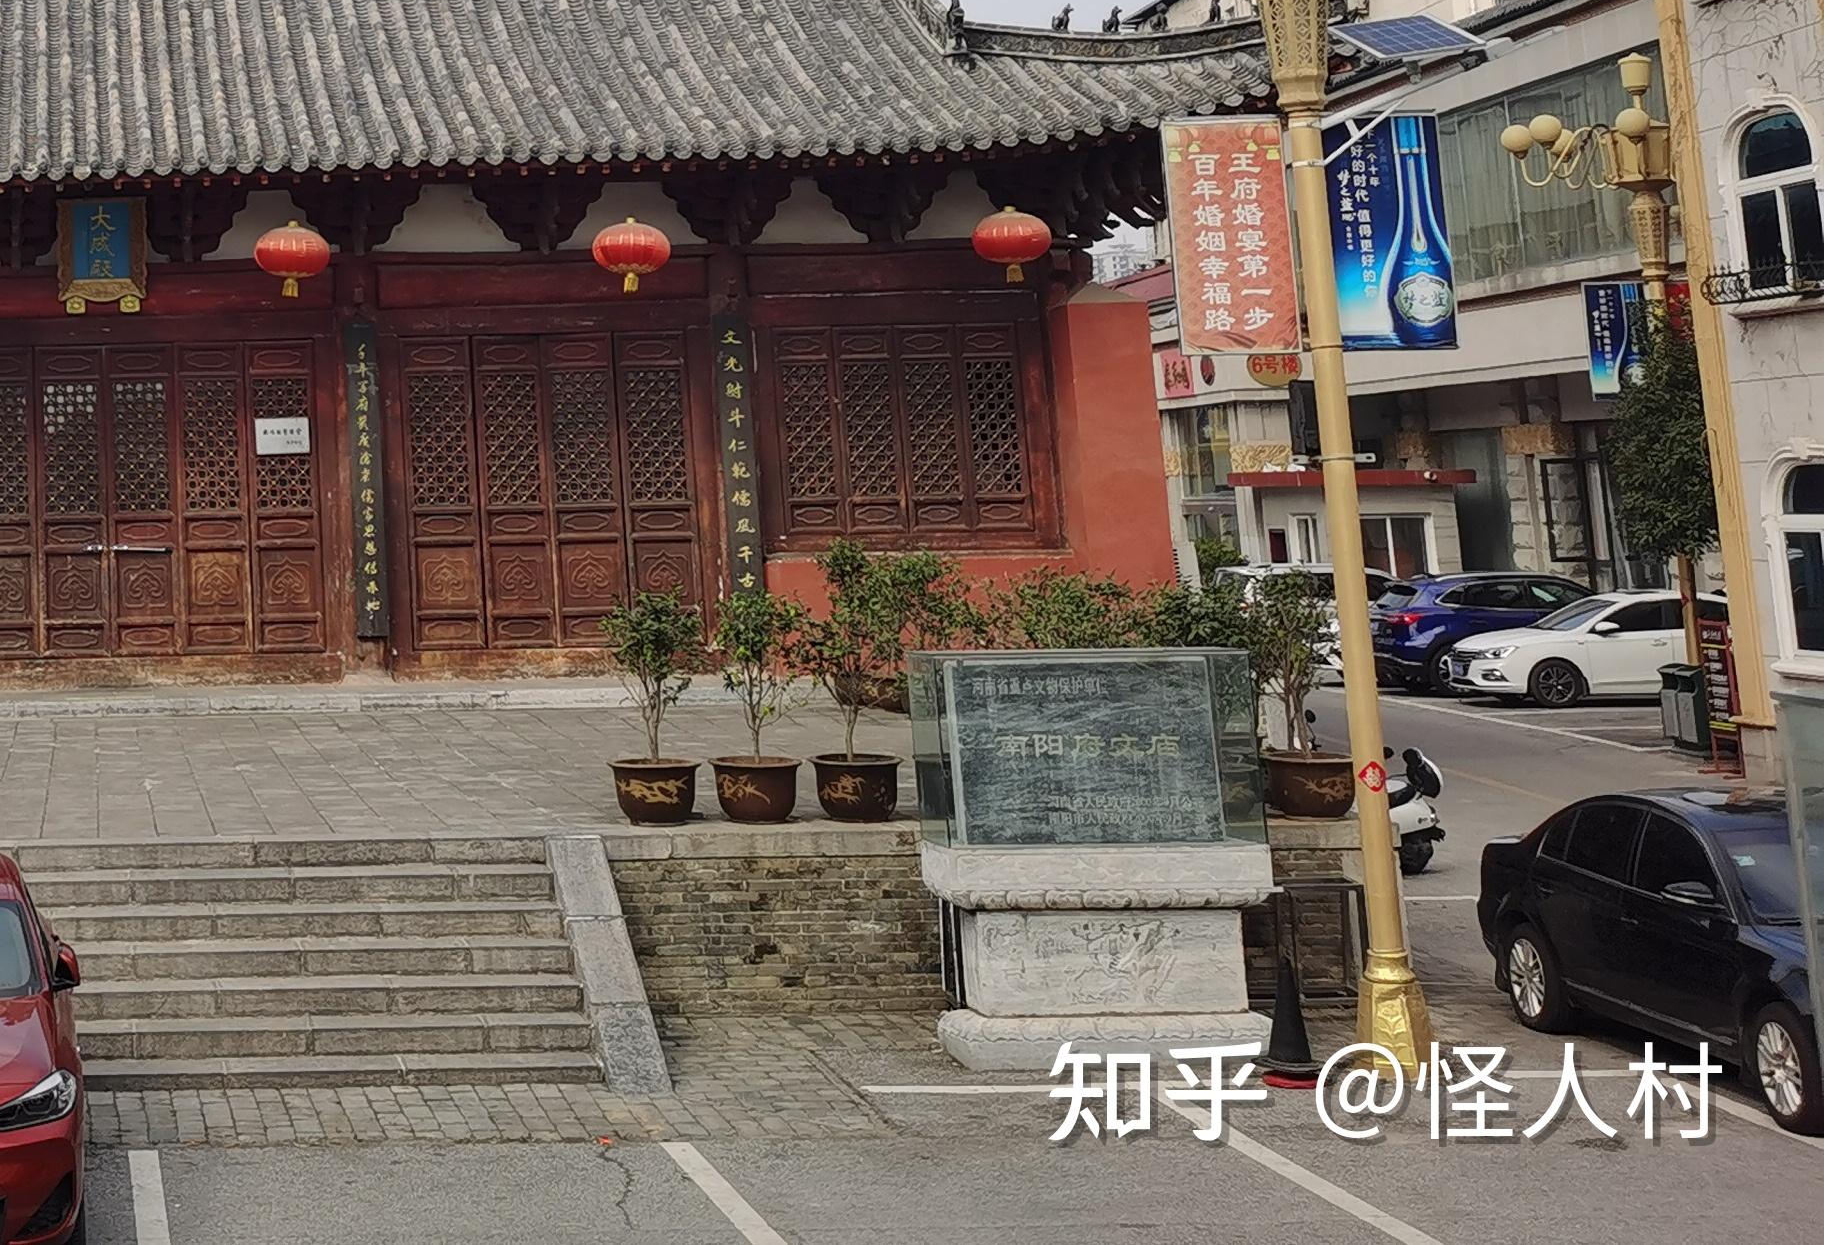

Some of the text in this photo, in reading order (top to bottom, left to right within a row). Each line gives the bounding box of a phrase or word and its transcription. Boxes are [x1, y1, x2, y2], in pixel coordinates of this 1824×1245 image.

[88, 205, 116, 279] 大成殿
[1188, 153, 1236, 332] 百年婚姻幸福路
[1227, 152, 1275, 331] 王府婚宴第一步
[994, 731, 1182, 759] 南阳府文庙
